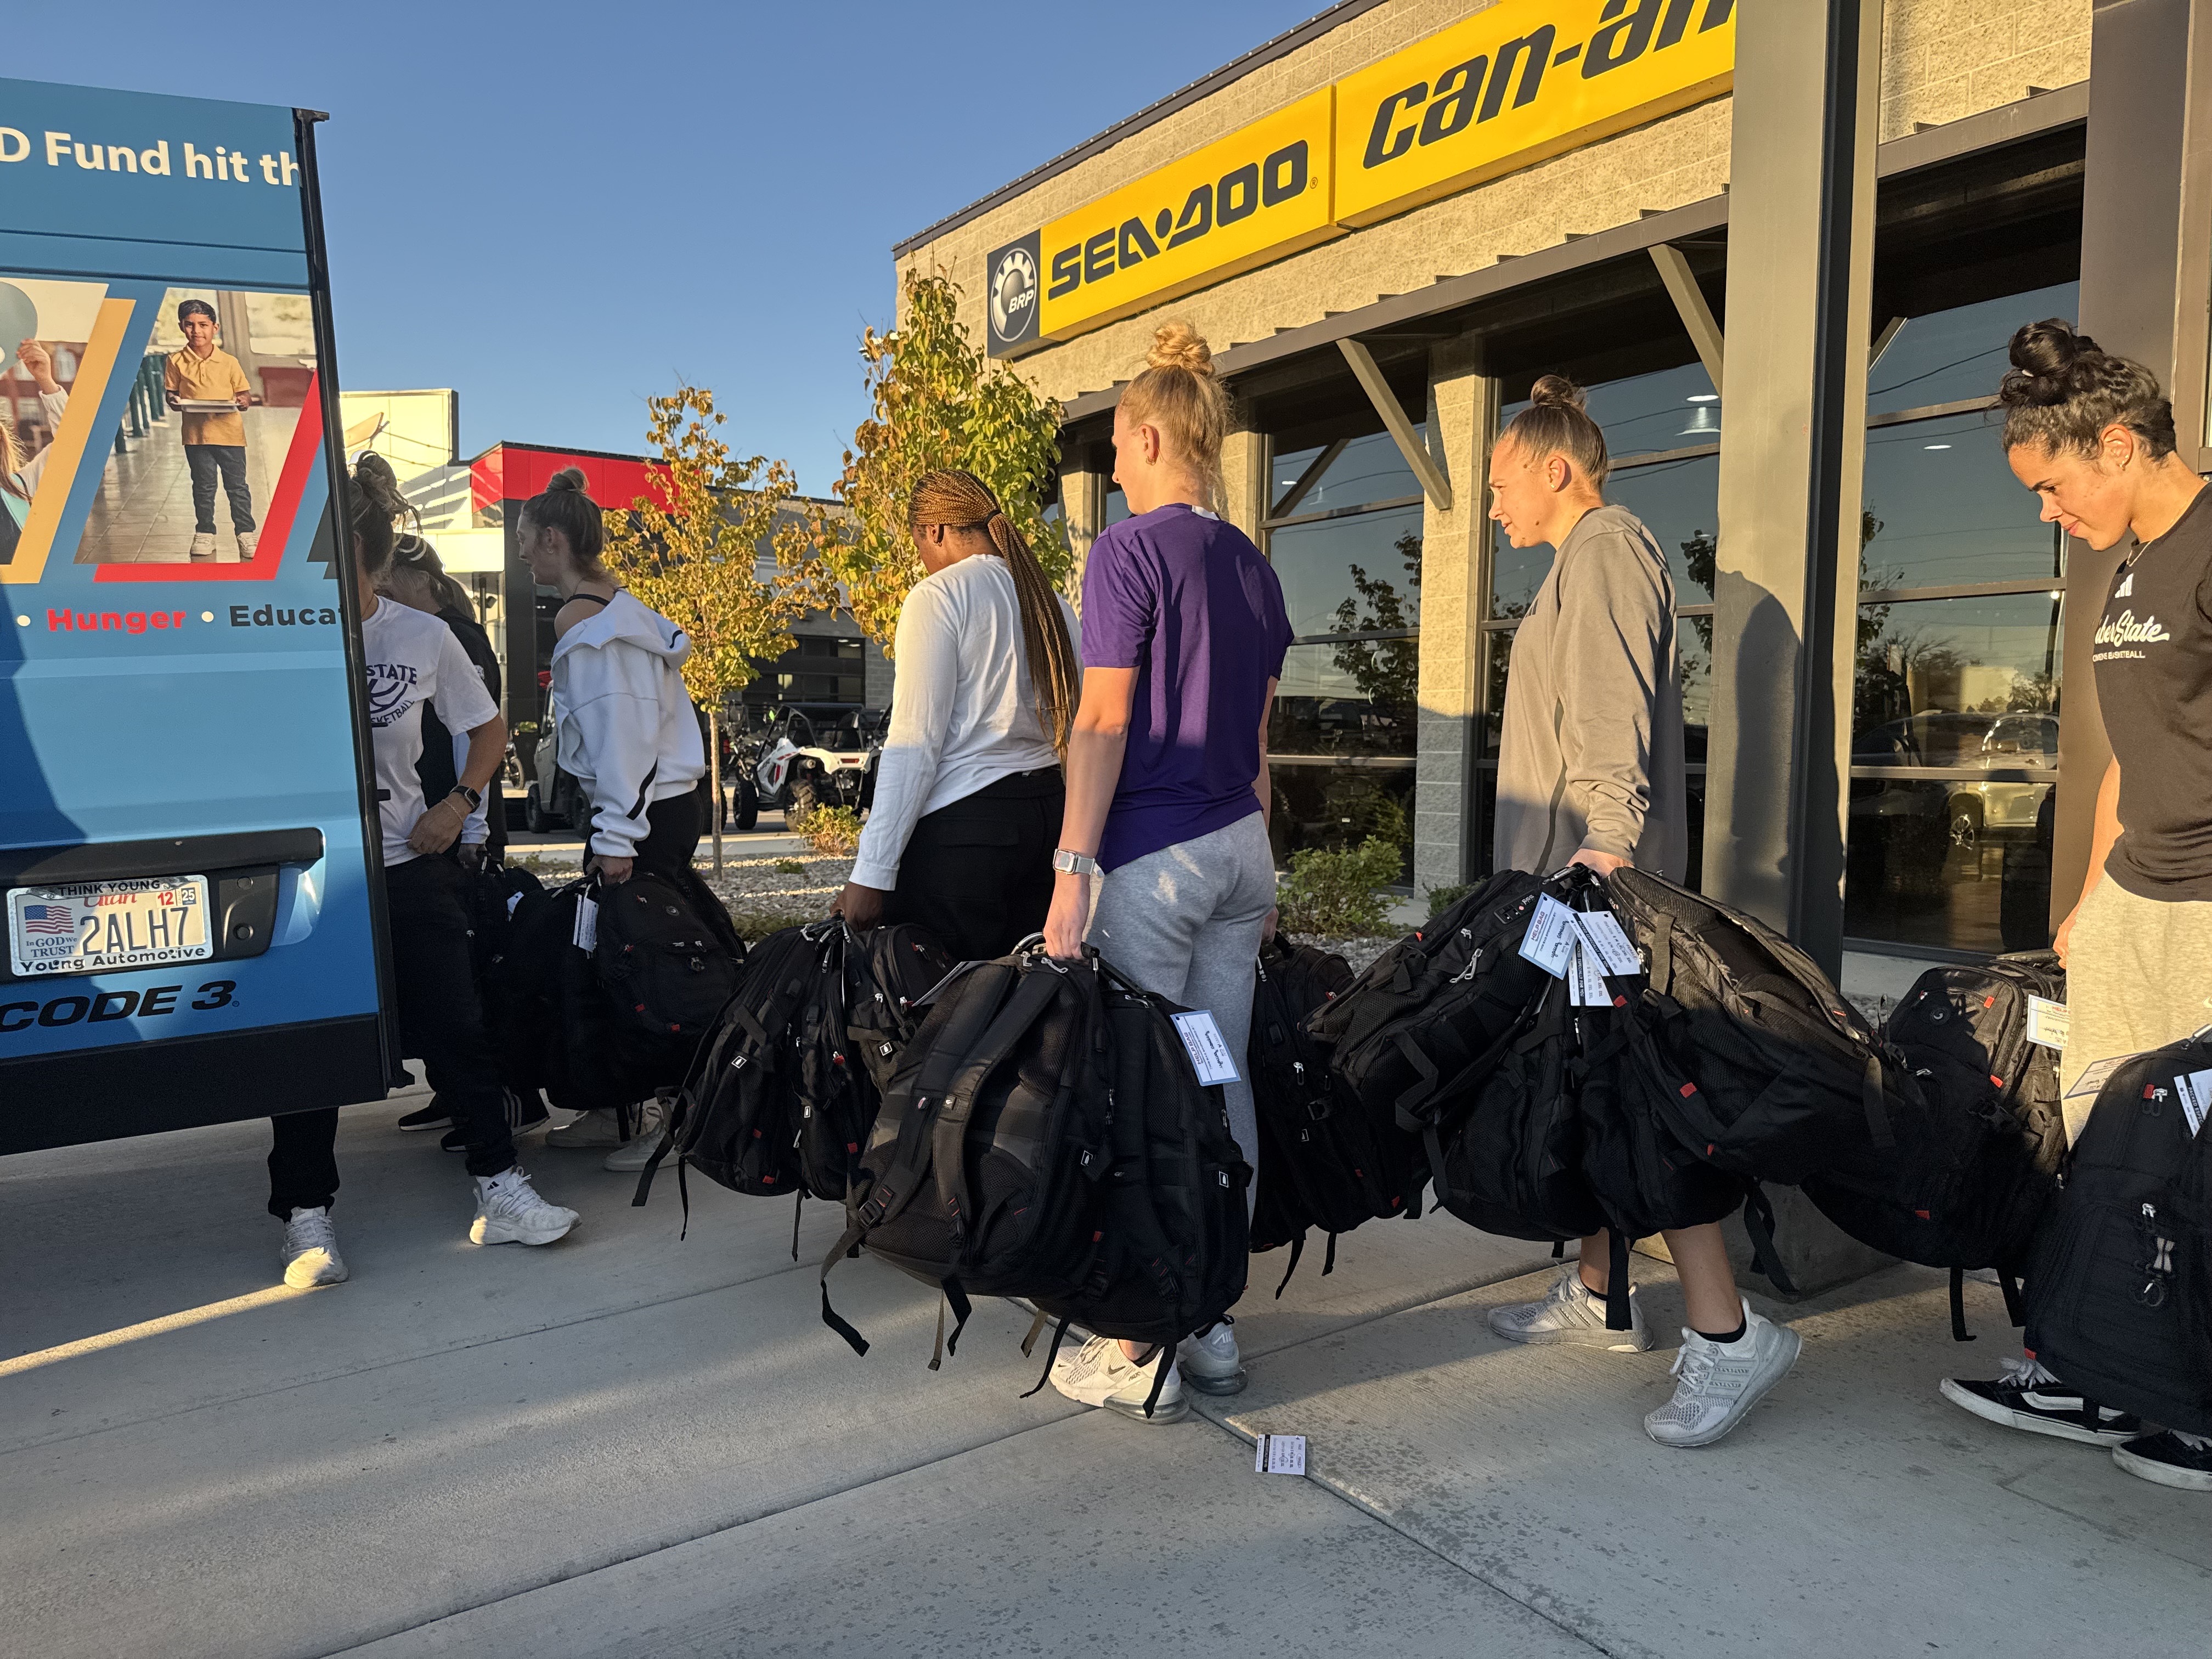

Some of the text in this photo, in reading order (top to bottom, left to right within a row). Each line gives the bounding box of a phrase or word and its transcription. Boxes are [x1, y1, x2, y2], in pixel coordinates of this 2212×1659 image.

[44, 131, 171, 176] Fund
[183, 143, 250, 183] hit
[1008, 289, 1034, 314] BRP
[47, 604, 341, 635] Hunger Educa
[2114, 609, 2170, 647] State
[366, 663, 417, 685] STATE
[58, 879, 161, 896] THINK YOUNG
[157, 891, 174, 906] 12
[182, 889, 195, 901] 25
[80, 907, 189, 955] 2ALH7
[1531, 924, 1540, 940] HELP
[1536, 911, 1545, 924] BAG
[31, 945, 74, 958] TRUST
[35, 936, 65, 947] GOD
[20, 957, 85, 973] Young
[0, 980, 236, 1032] CODE 3
[2187, 1087, 2197, 1107] PACKED
